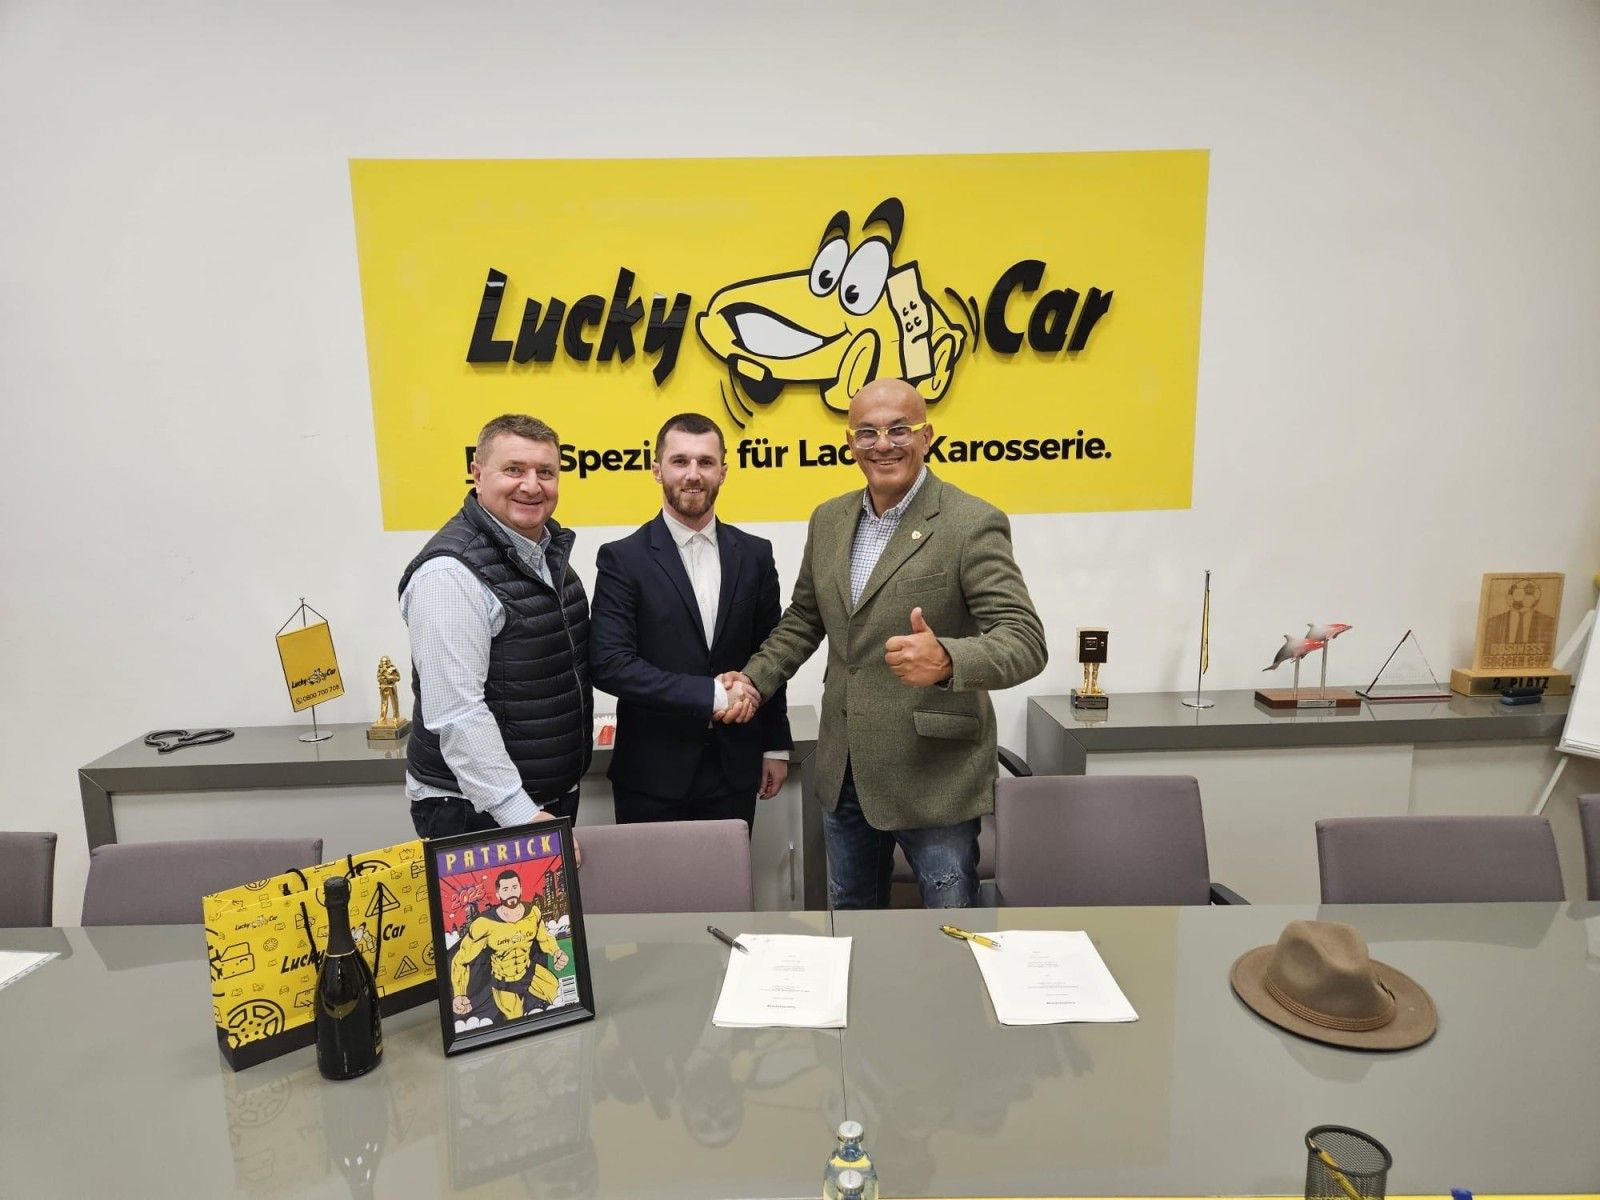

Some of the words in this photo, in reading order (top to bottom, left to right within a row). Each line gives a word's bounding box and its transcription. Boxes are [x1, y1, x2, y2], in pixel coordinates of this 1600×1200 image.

[466, 266, 692, 387] Lucky
[984, 259, 1114, 353] Car
[559, 440, 653, 479] Spezi
[737, 438, 788, 468] für
[799, 439, 857, 467] Lac
[924, 429, 1112, 463] Karosserie.
[1489, 643, 1546, 655] BUSINESS
[445, 835, 552, 872] PATRICK
[234, 923, 250, 931] Lucky
[268, 914, 278, 922] Car
[382, 922, 406, 941] Car
